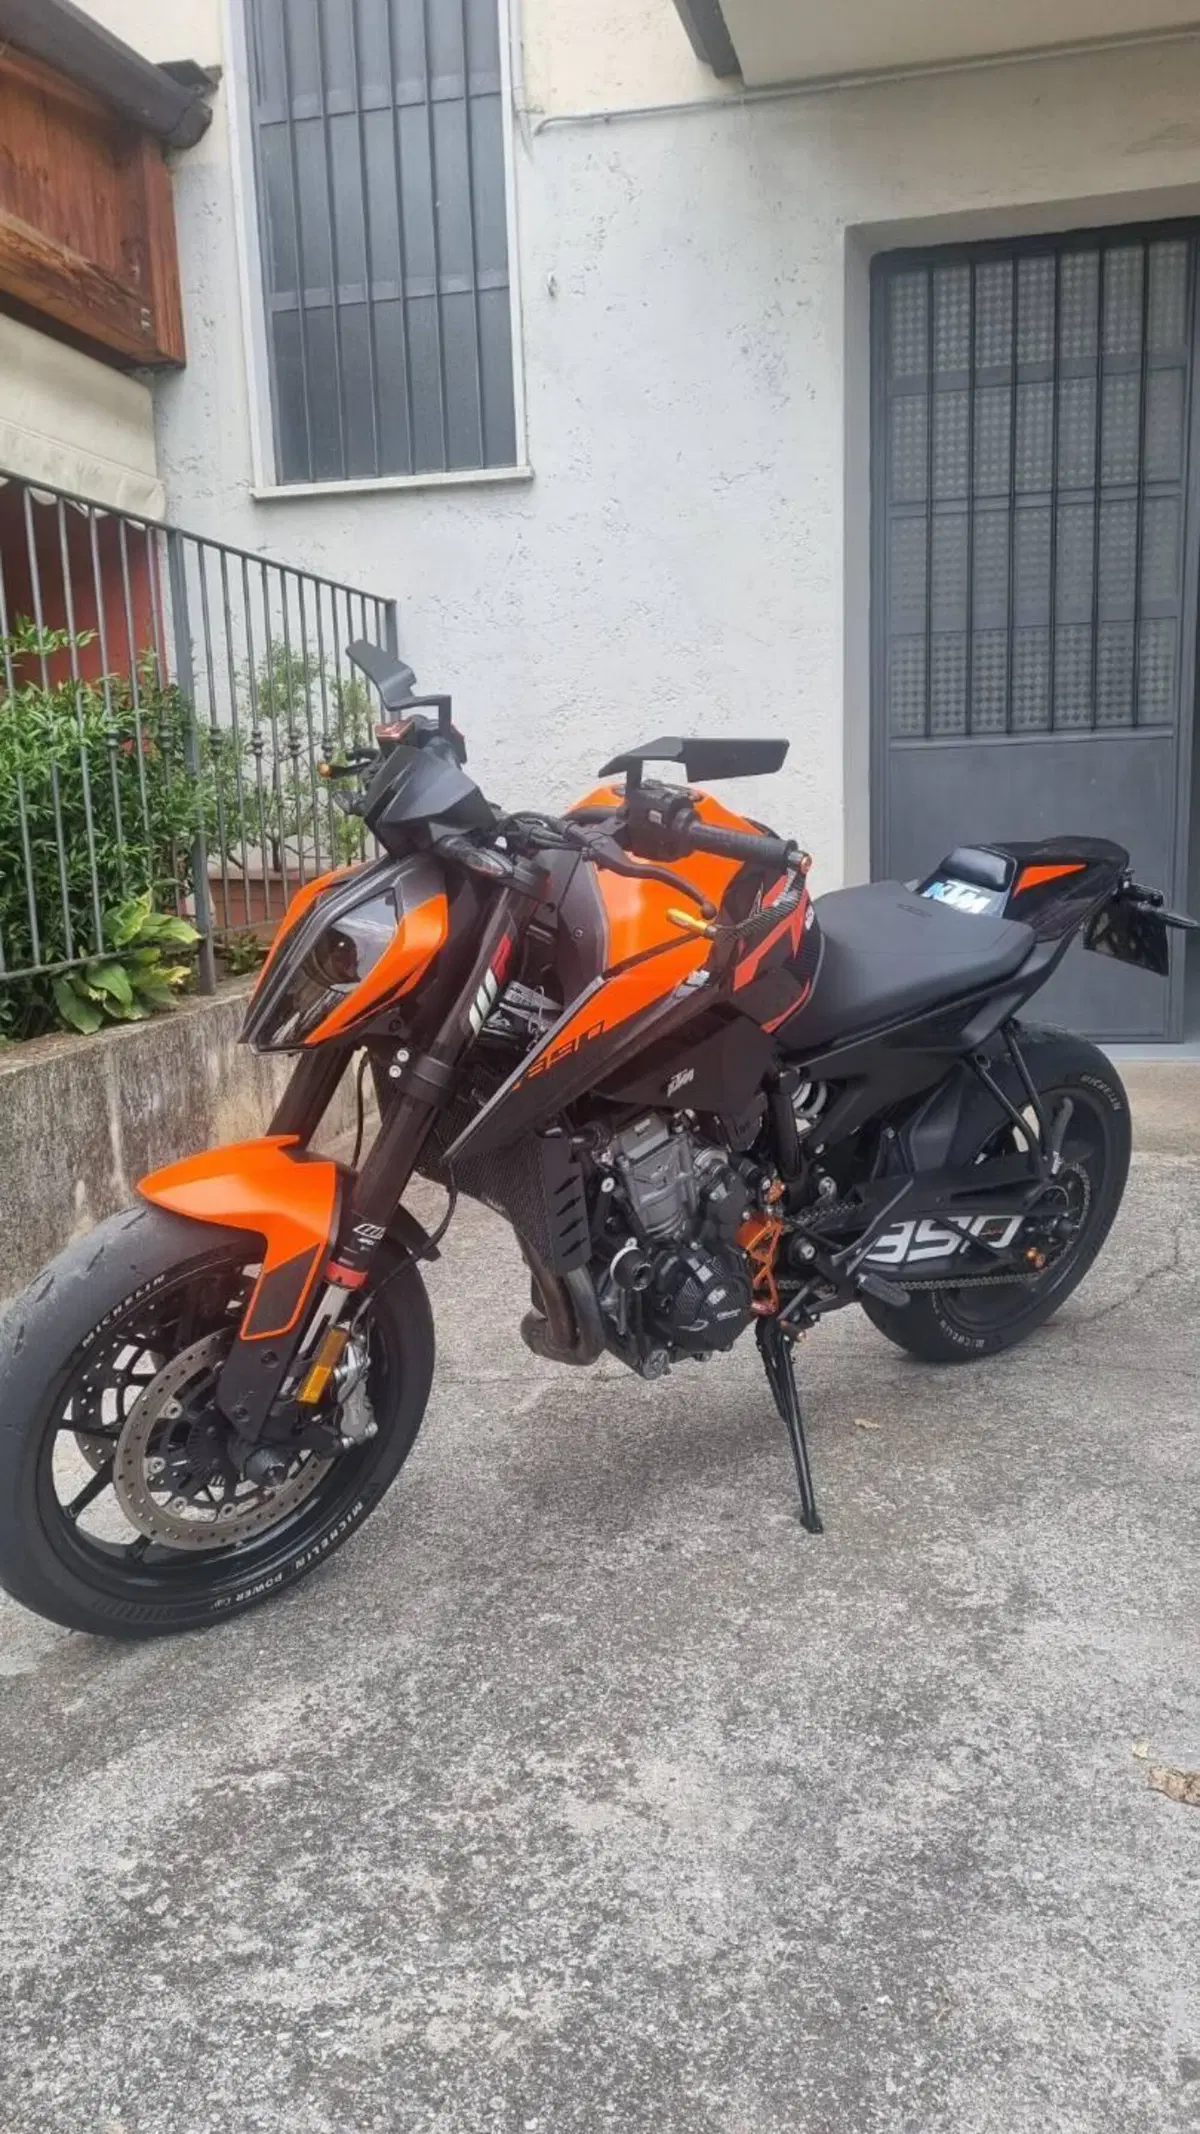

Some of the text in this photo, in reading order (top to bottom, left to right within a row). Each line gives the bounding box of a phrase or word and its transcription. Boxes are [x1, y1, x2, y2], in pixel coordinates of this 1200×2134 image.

[82, 1274, 165, 1347] MICHELIN
[295, 1502, 363, 1569] MICHELIN
[236, 1572, 283, 1602] POWER
